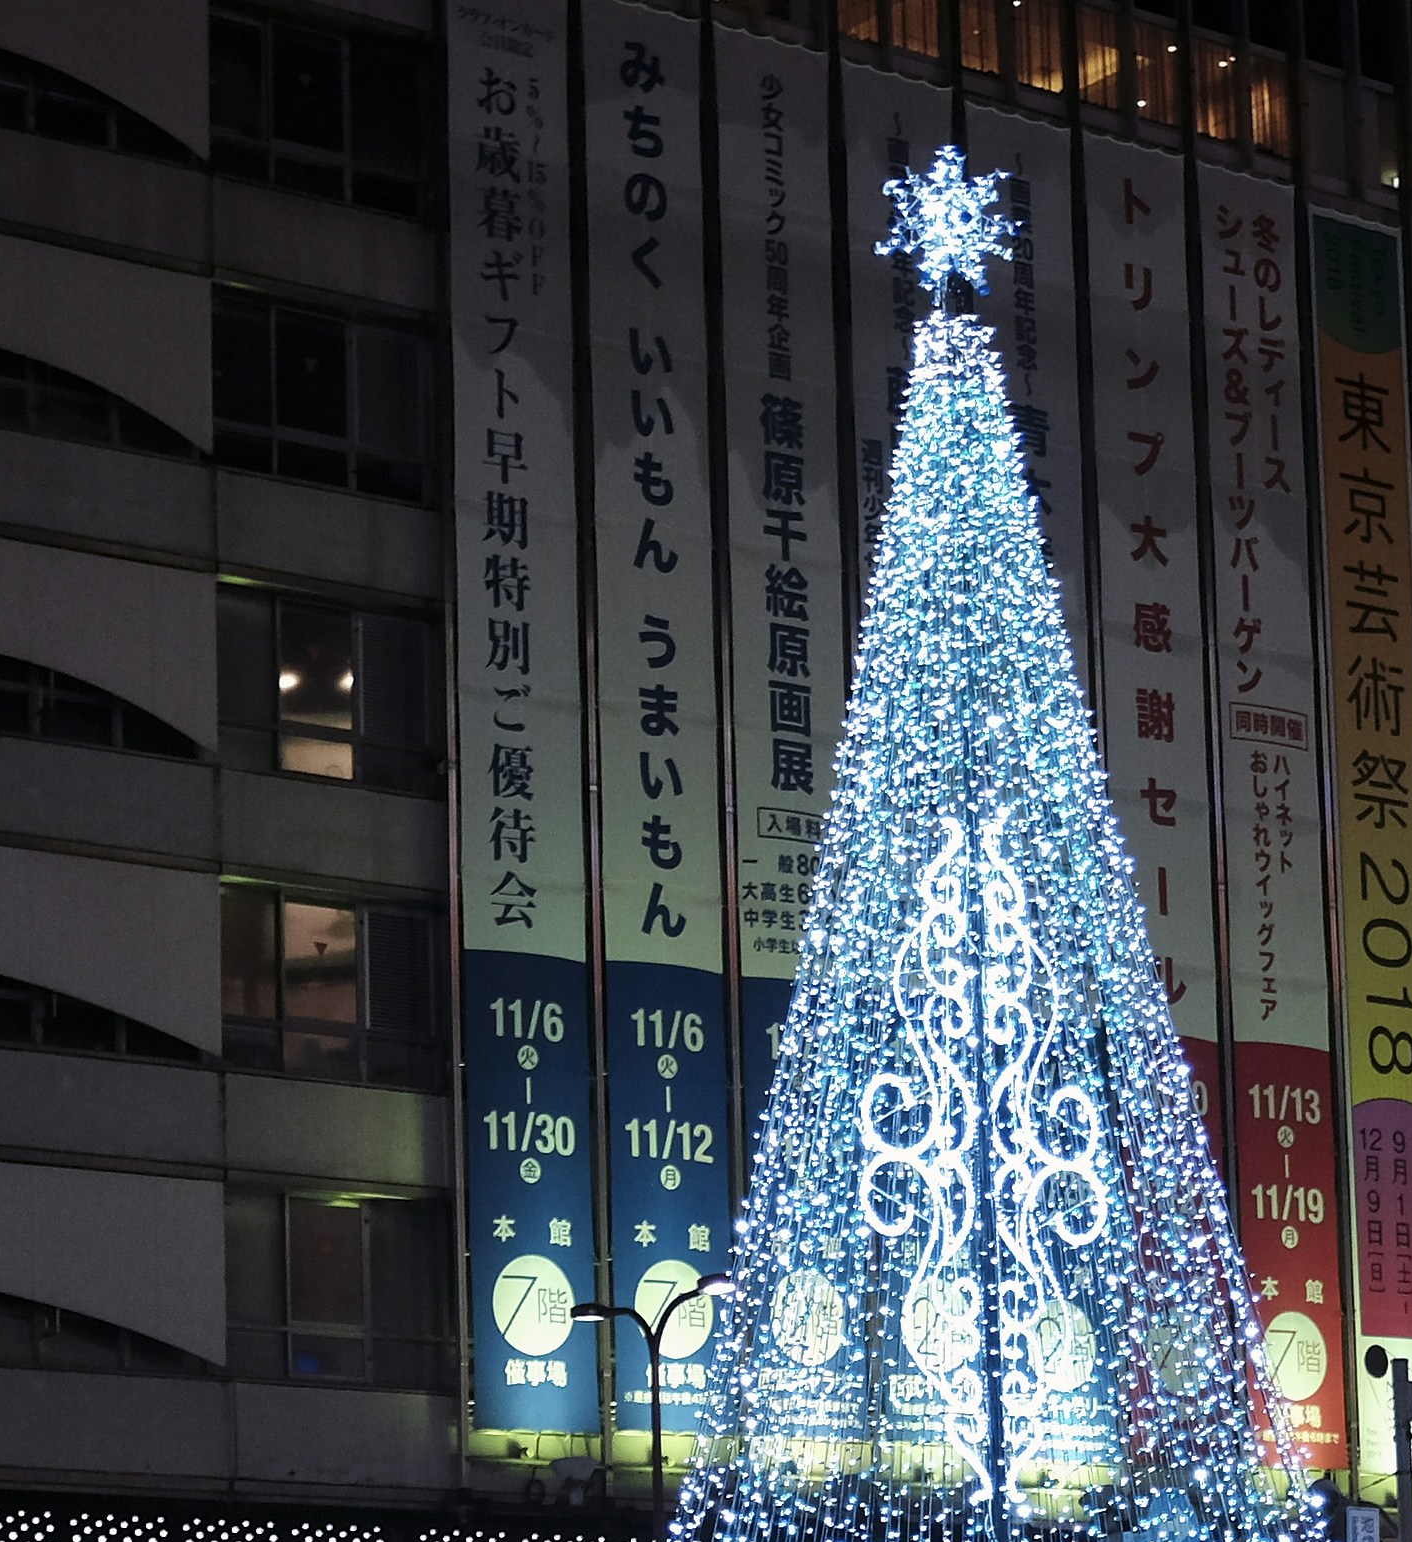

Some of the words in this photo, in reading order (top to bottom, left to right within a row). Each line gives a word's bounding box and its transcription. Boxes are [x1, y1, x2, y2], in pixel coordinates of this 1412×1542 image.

[619, 41, 667, 290] みちのく
[1251, 214, 1292, 494] 冬のレディース
[629, 327, 678, 575] いいもん
[1216, 205, 1263, 694] シューズ&ブーツバーゲン
[475, 67, 537, 930] お歳暮ギフト早期特別ご優待会
[760, 393, 813, 796] 篠原千絵原画展
[1124, 178, 1186, 1005] トリンプ大感謝セール
[1236, 711, 1303, 742] 同時開催
[638, 614, 686, 938] うまいもん
[767, 814, 821, 839] 入場料
[1273, 755, 1293, 873] ハイネット
[1250, 750, 1278, 1021] おしゃれウイッグフェア
[490, 997, 565, 1043] 11/6
[630, 1008, 705, 1054] 11/6
[1248, 1084, 1322, 1125] 11/13
[484, 1110, 576, 1157] 11/30
[625, 1117, 714, 1165] 11/12
[660, 1165, 681, 1190] 月
[1251, 1183, 1326, 1225] 11/19
[492, 1214, 573, 1249] 本館
[634, 1219, 711, 1253] 本館
[502, 1274, 568, 1336] 7階
